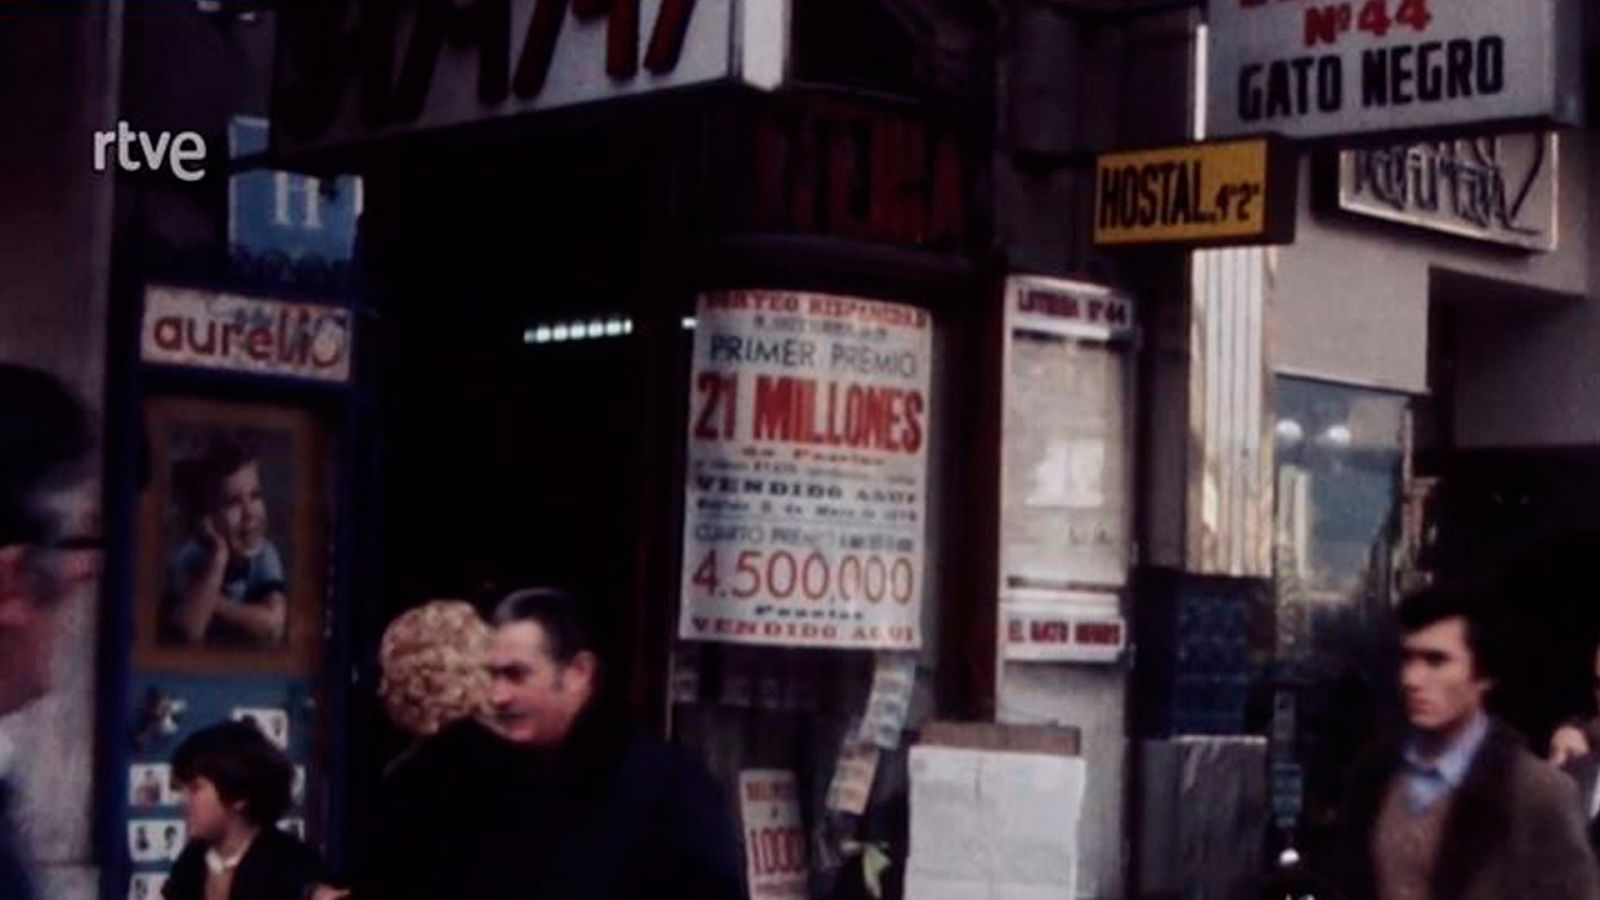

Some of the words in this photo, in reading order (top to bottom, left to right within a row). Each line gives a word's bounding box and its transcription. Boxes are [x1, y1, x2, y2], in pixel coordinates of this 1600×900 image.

[1358, 0, 1432, 35] 44
[1238, 55, 1341, 120] GATO
[1363, 36, 1503, 106] NEGRO
[709, 335, 816, 369] PRIMER
[830, 342, 918, 378] PREMIO
[693, 371, 738, 440] 21
[753, 373, 924, 454] MILLONES
[695, 474, 843, 499] VENDIDO
[692, 616, 837, 638] VENDIDO
